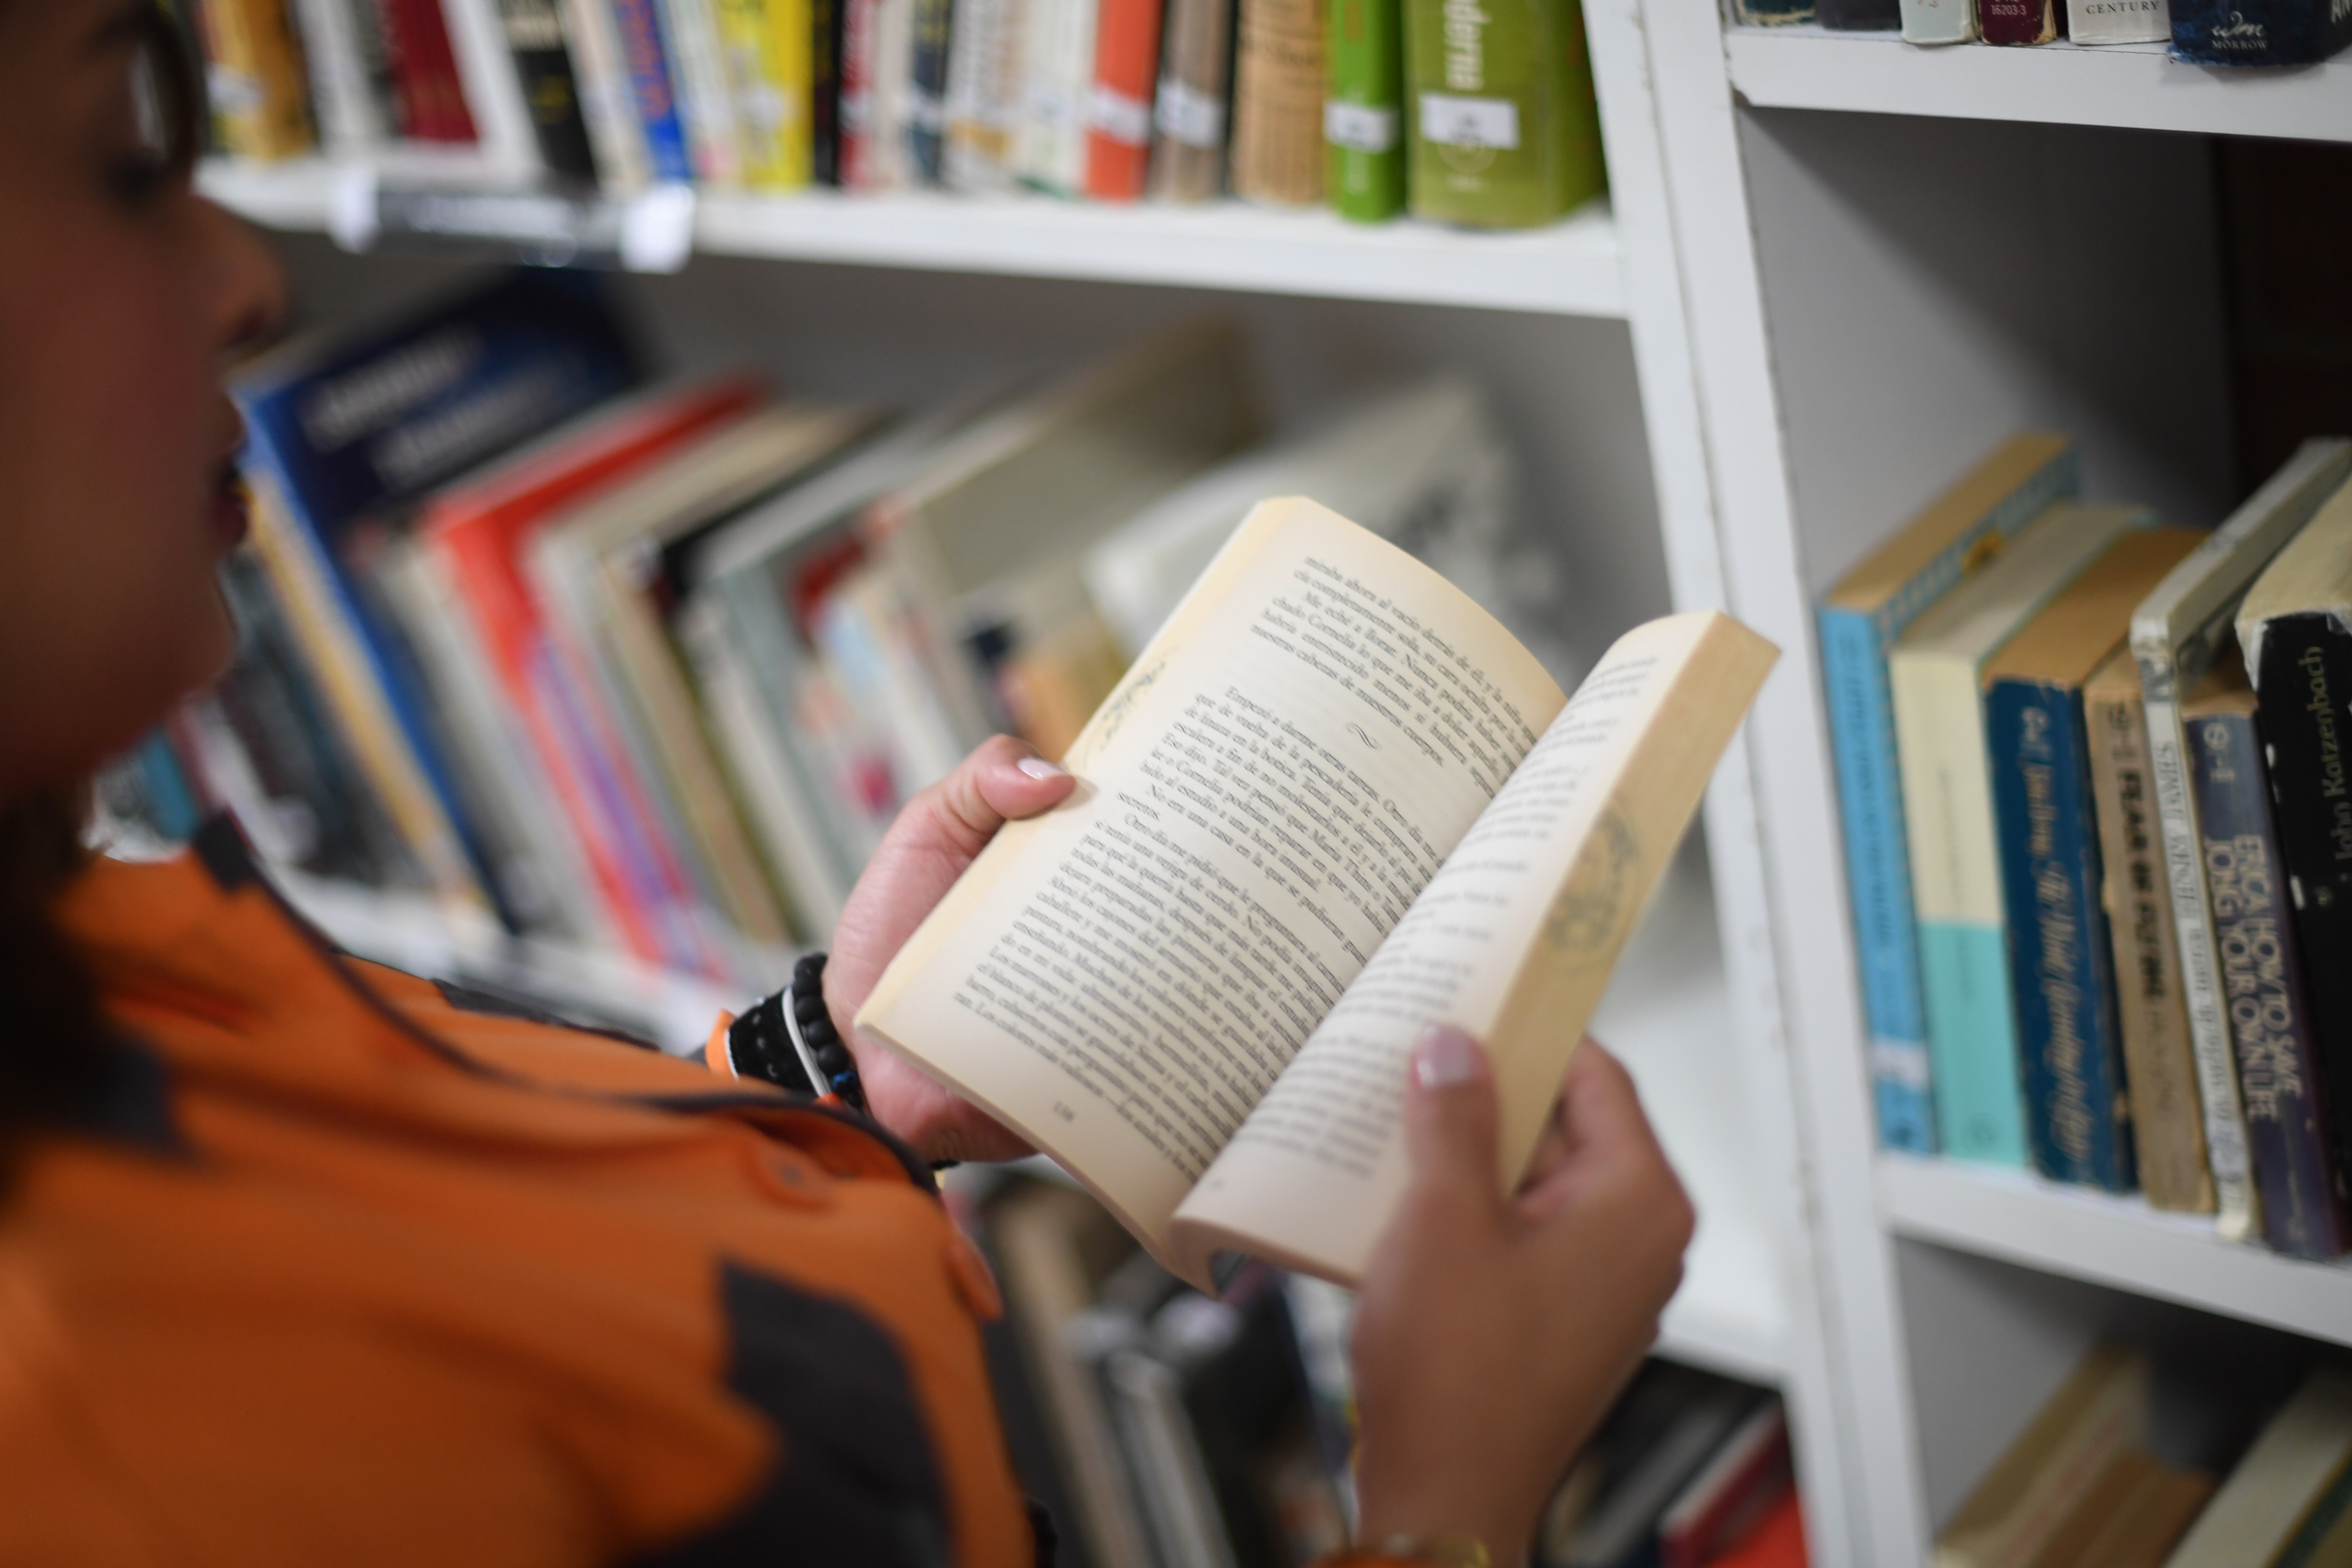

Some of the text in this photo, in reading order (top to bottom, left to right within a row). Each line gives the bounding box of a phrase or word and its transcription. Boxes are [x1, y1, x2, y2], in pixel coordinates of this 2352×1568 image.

[1991, 5, 2027, 16] 16203-3
[2086, 1, 2159, 14] CENTURY
[2212, 39, 2267, 50] MORROW
[2298, 646, 2347, 798] Katzenbach
[2204, 836, 2243, 921] JONG
[2235, 833, 2273, 914] ERICA
[2216, 925, 2258, 997] YOUR
[2242, 916, 2287, 991] HOW
[2261, 984, 2293, 1032] TO
